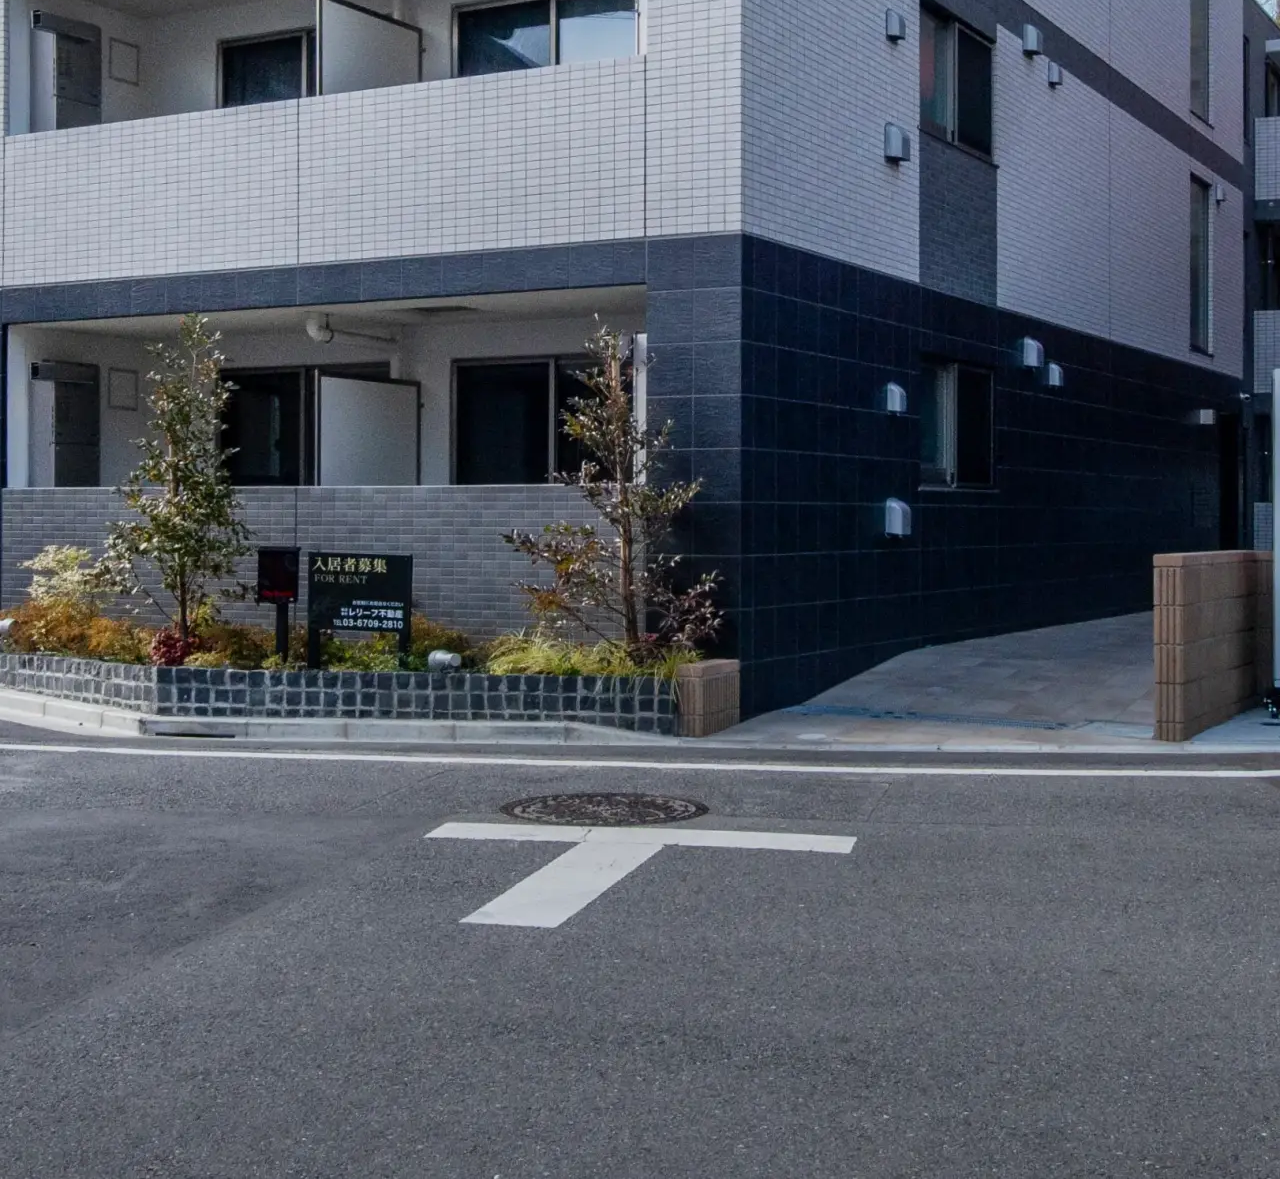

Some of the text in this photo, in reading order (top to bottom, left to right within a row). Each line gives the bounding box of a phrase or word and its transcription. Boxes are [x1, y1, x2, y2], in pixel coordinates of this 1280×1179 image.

[312, 556, 387, 573] 入居者募集
[314, 573, 367, 584] FOR RENT
[343, 619, 403, 628] 03-6709-2810
